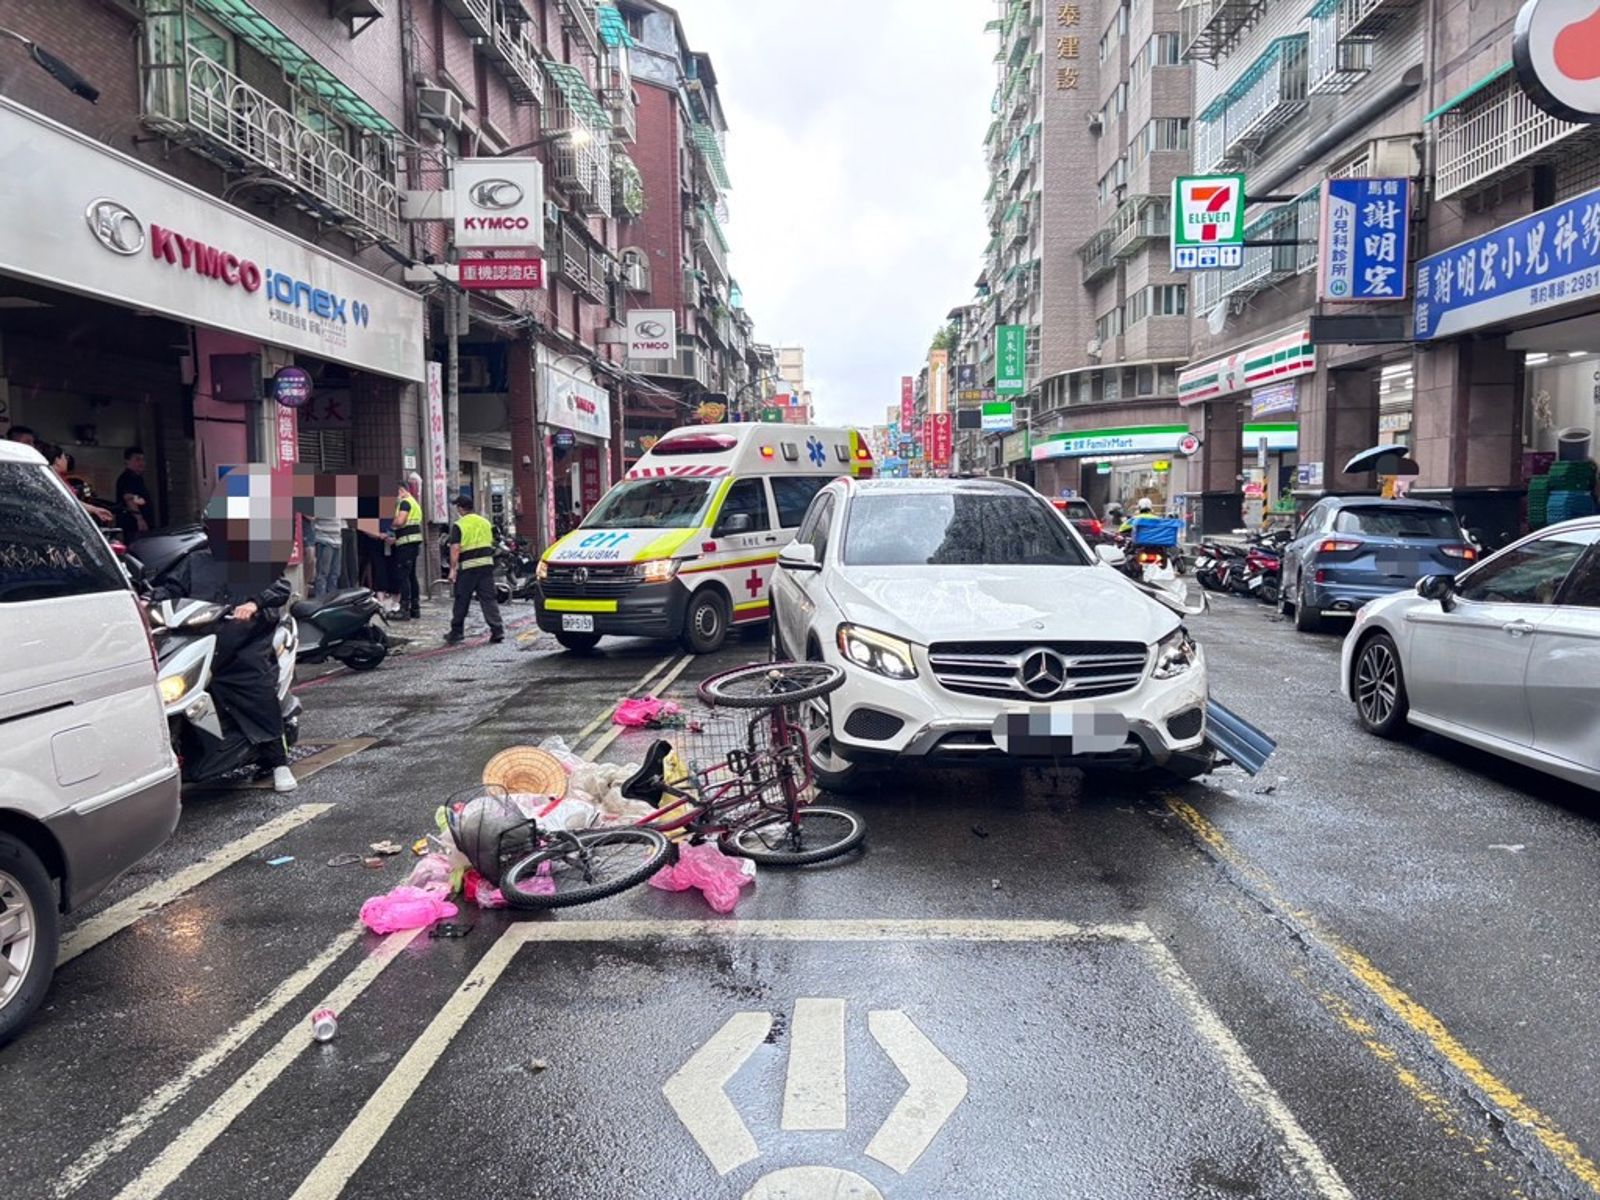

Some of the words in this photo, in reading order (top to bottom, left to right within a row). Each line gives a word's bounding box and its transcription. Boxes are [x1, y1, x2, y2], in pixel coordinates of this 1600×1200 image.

[464, 217, 529, 231] KYMCO
[1332, 206, 1350, 277] 小兒科診所
[1363, 199, 1401, 295] 謝明宏
[150, 223, 261, 293] KYMCO
[463, 265, 538, 281] 重機認證店
[632, 341, 669, 350] KYMCO
[1086, 438, 1133, 449] FamilyMart
